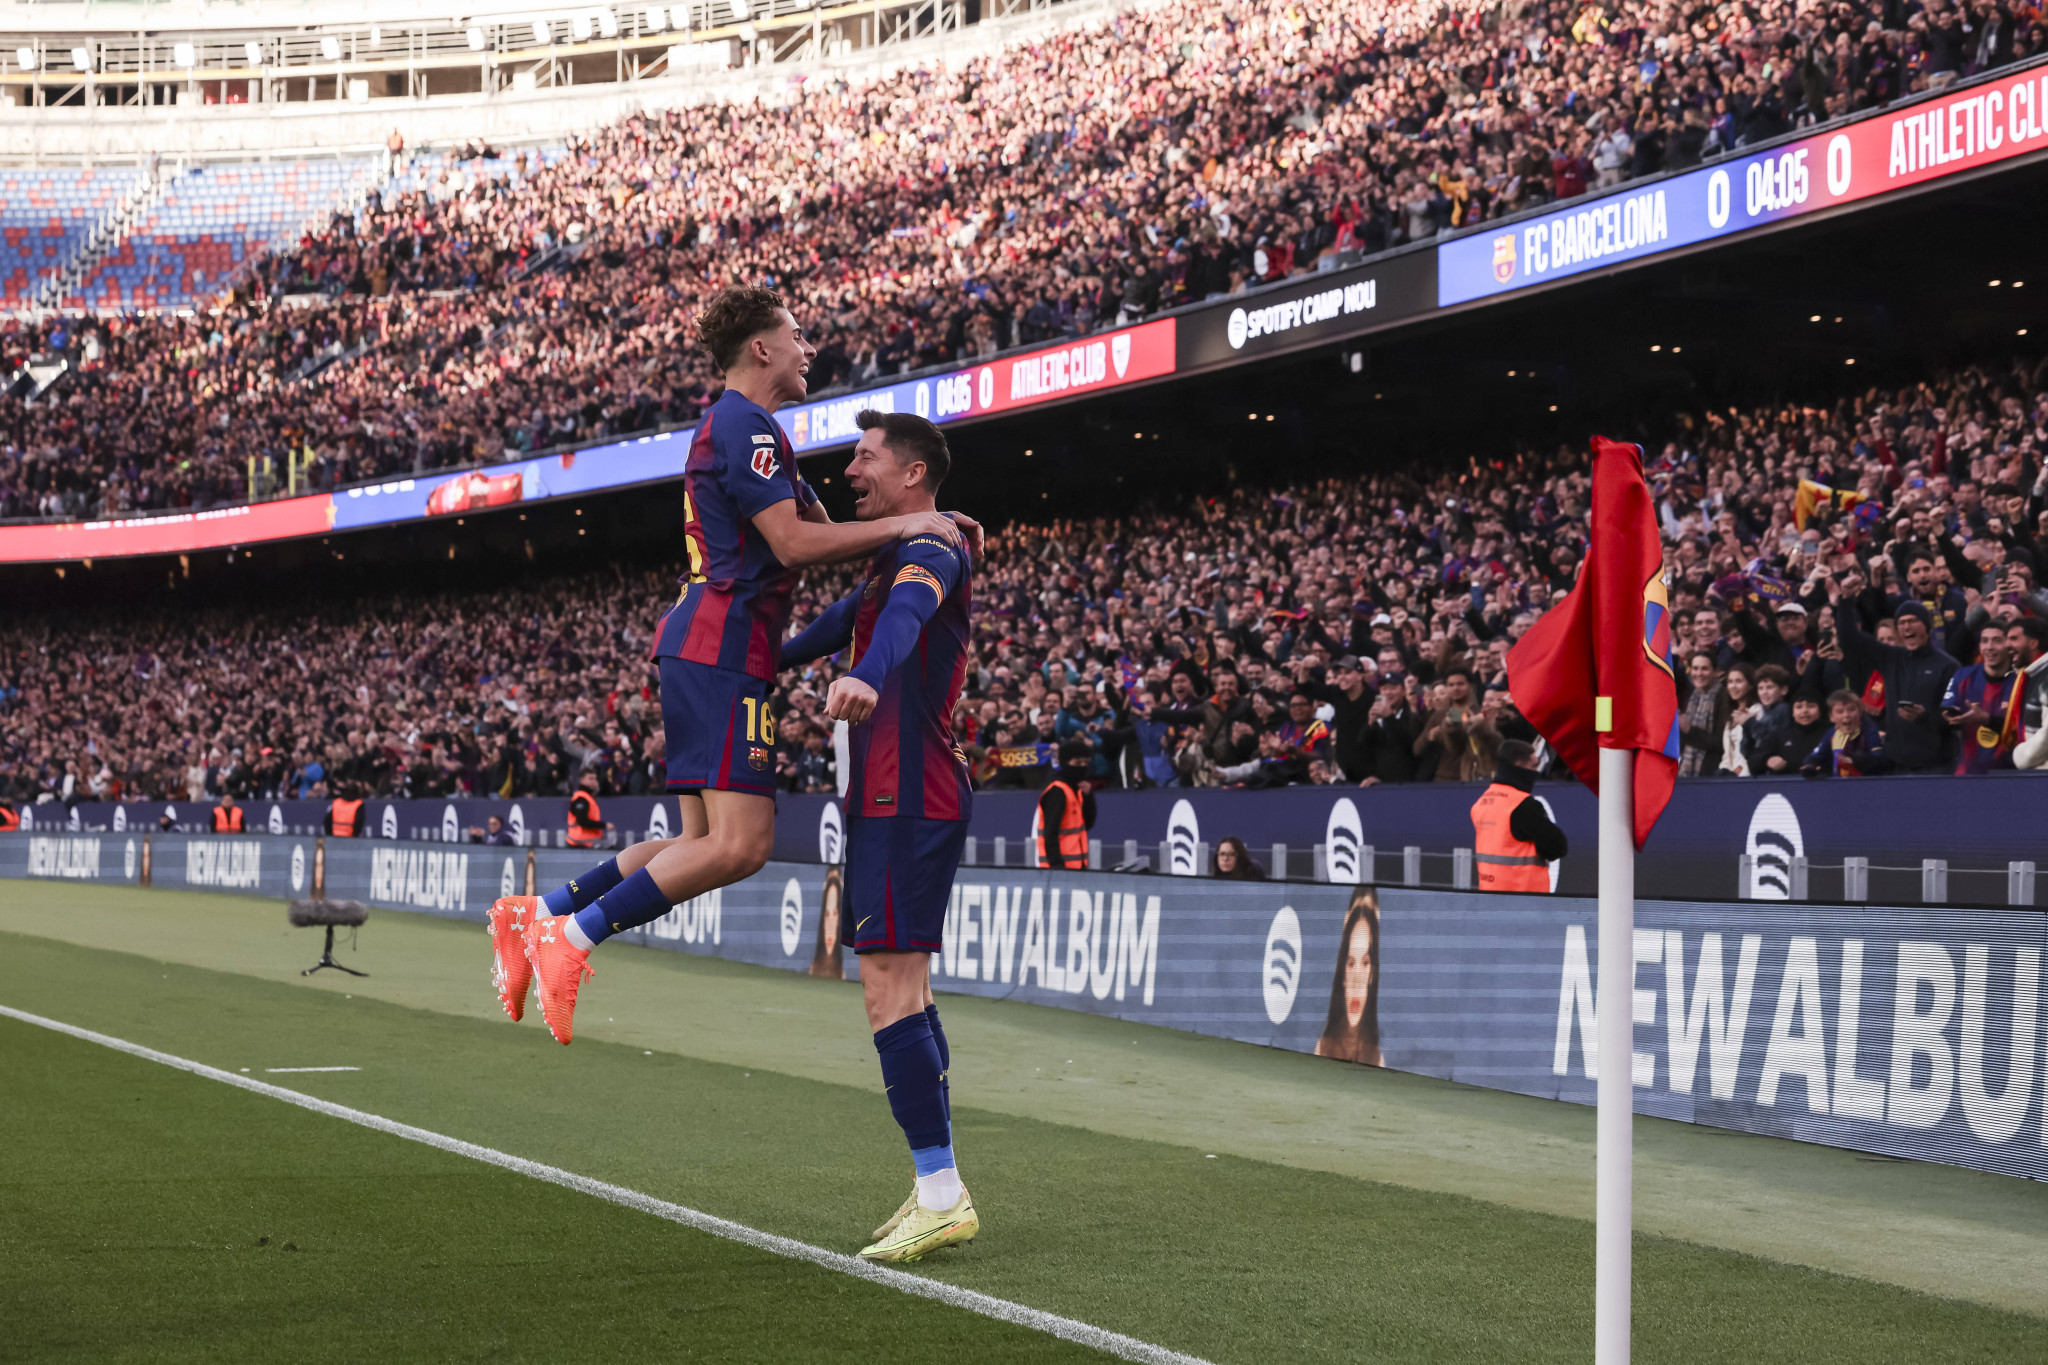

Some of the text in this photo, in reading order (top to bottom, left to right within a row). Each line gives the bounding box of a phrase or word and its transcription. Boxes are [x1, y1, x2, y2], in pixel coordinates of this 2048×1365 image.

[1524, 223, 1549, 276] FC
[1552, 190, 1668, 269] BARCELONA
[1707, 170, 1731, 228] 0
[1746, 148, 1809, 217] 04:05
[1827, 134, 1851, 197] 0
[1889, 91, 2004, 178] ATHLETIC
[1248, 279, 1376, 338] SPOTIFY CAMP NOU
[812, 405, 828, 442] FC
[916, 382, 929, 418] 0
[979, 366, 994, 409] 0
[1011, 350, 1070, 401] ATHLETIC
[1070, 341, 1107, 387] CLUB
[907, 538, 951, 553] AMBILIGHT
[742, 696, 776, 746] 16
[28, 837, 101, 879] NEW ALBUM
[186, 840, 261, 888] NEW ALBUM
[370, 847, 468, 911] NEW ALBUM
[931, 883, 1161, 1005] NEW ALBUM
[1553, 924, 2048, 1149] NEW ALBU
